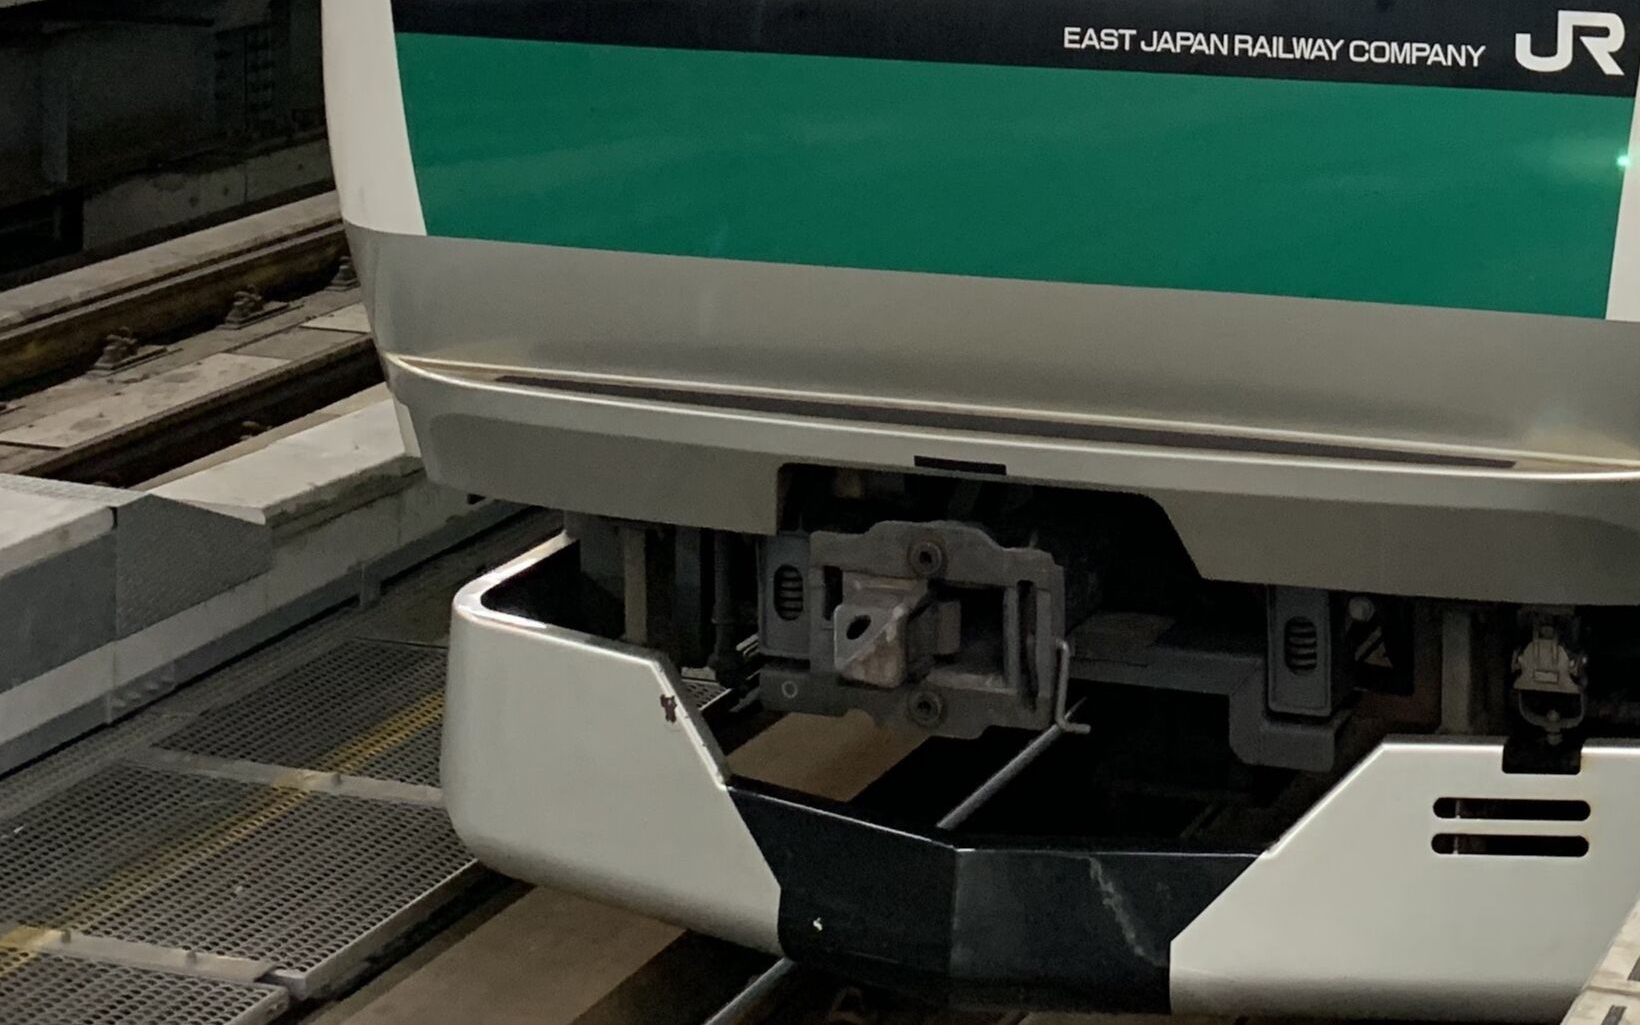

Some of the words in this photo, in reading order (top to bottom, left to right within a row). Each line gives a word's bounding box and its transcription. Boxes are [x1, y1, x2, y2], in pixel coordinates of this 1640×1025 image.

[1063, 27, 1137, 51] EAST
[1140, 30, 1228, 56] JAPAN
[1234, 34, 1344, 61] RAILWAY
[1349, 39, 1486, 67] COMPANY
[1515, 10, 1625, 75] JR
